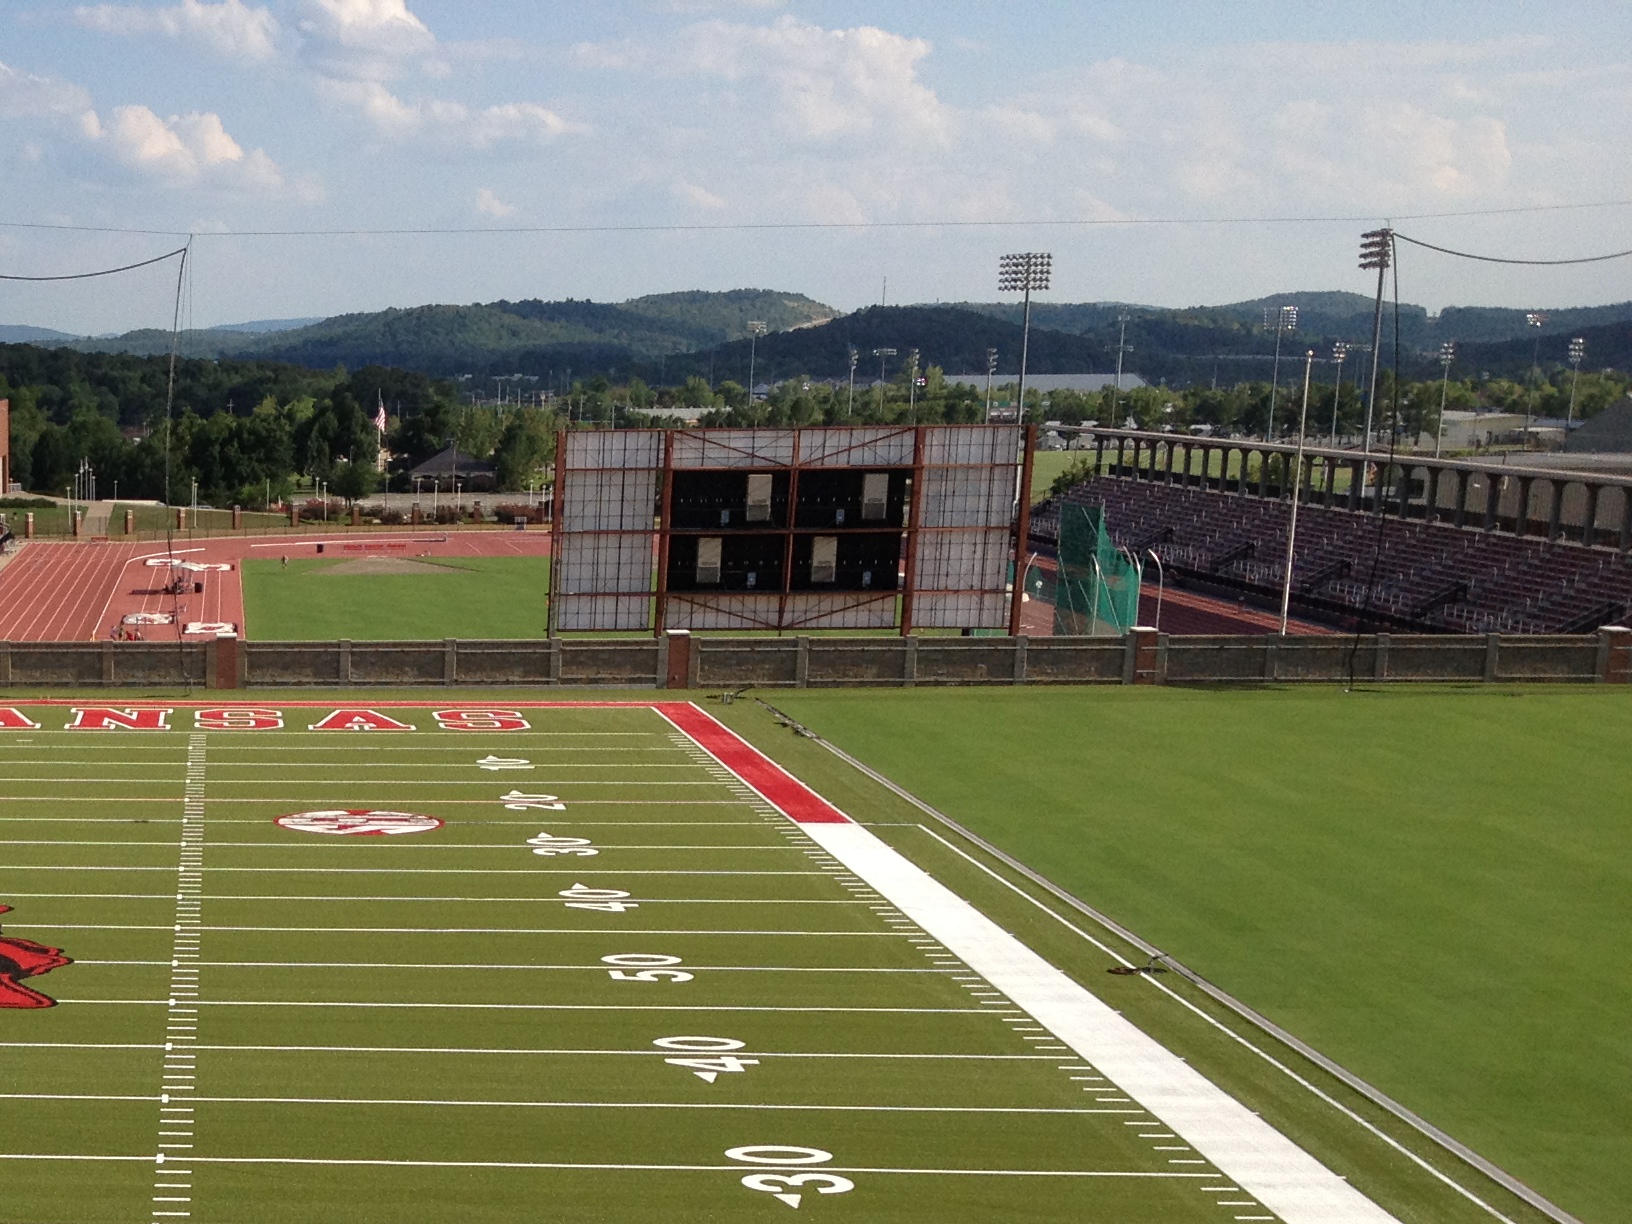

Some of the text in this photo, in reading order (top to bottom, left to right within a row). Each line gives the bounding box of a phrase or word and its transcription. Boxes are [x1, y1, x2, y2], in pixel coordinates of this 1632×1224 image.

[526, 837, 599, 856] 30
[558, 888, 640, 912] 40
[600, 953, 695, 982] 50
[652, 1035, 761, 1072] 40
[724, 1145, 855, 1195] 30
